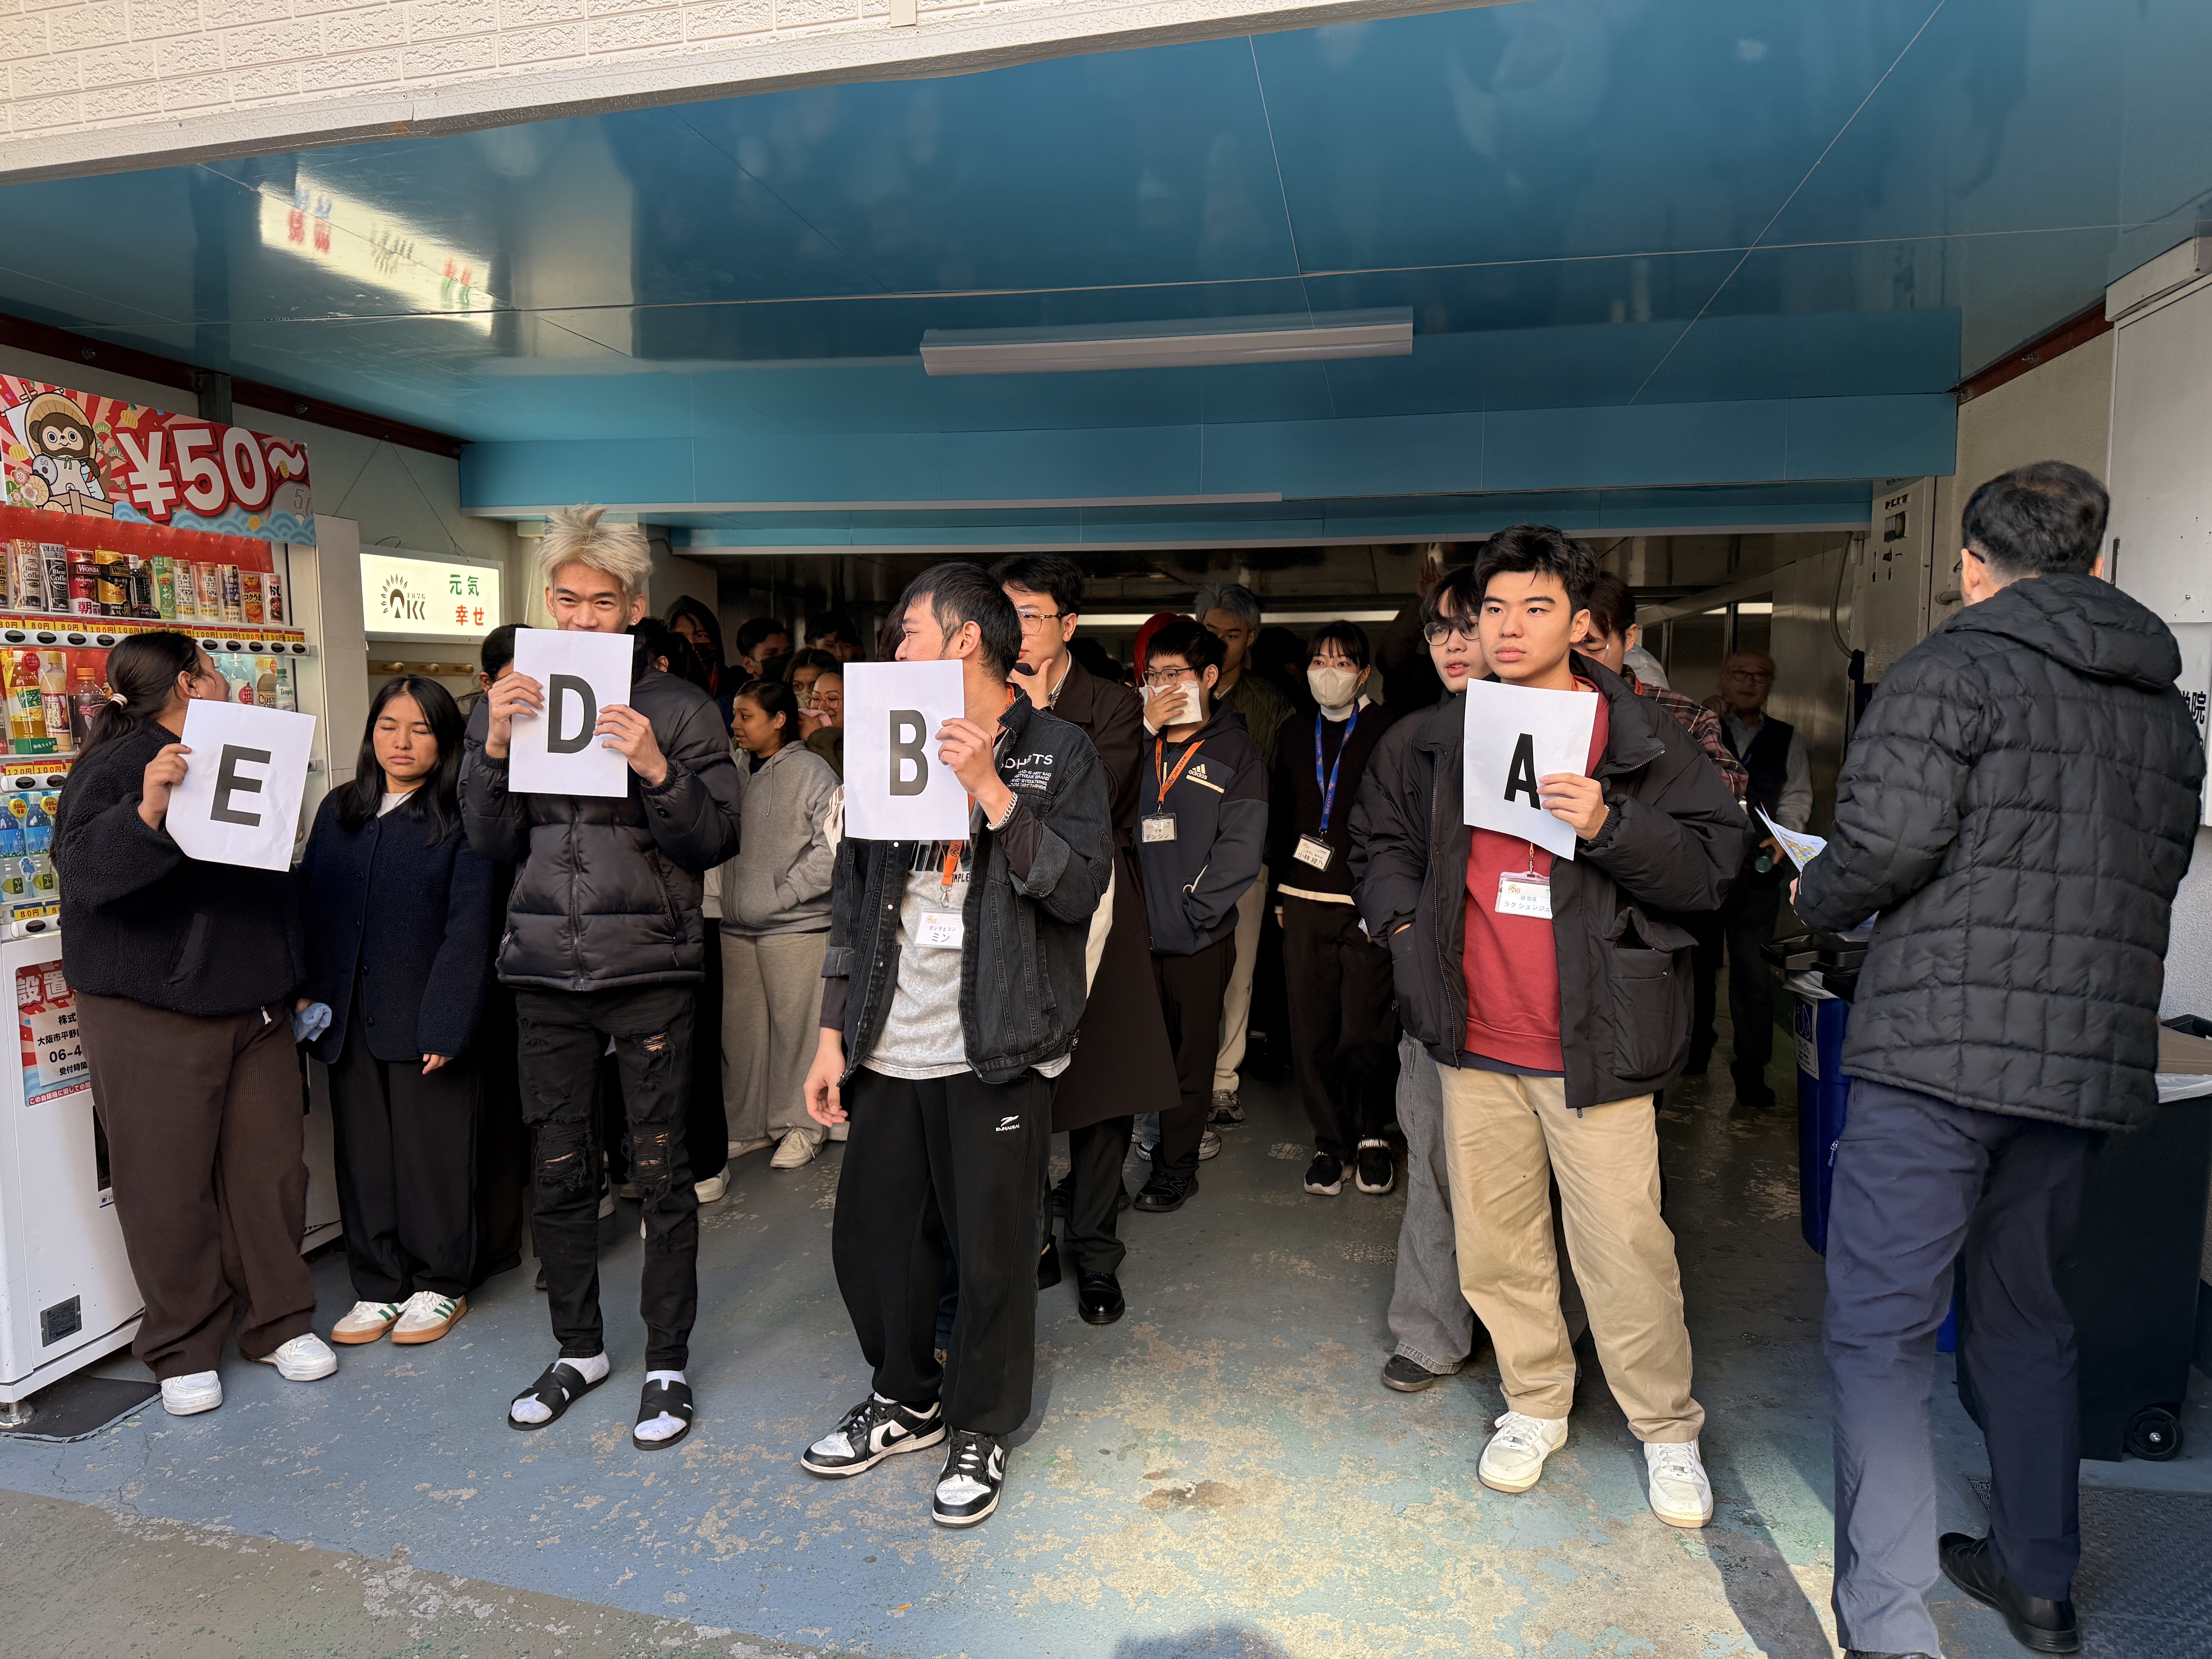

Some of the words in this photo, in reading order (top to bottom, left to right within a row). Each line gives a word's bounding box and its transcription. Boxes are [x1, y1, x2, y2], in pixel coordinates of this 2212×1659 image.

[449, 574, 479, 597] 元気
[78, 601, 92, 614] 朝
[455, 605, 485, 626] 幸せ
[61, 622, 79, 631] 80円
[547, 673, 597, 754] D
[890, 709, 928, 796] B
[1188, 769, 1208, 780] adidas
[1504, 733, 1541, 810] A
[210, 744, 271, 827] E
[21, 909, 39, 918] 80円
[931, 933, 950, 942] ミン
[58, 1013, 77, 1025] 株式
